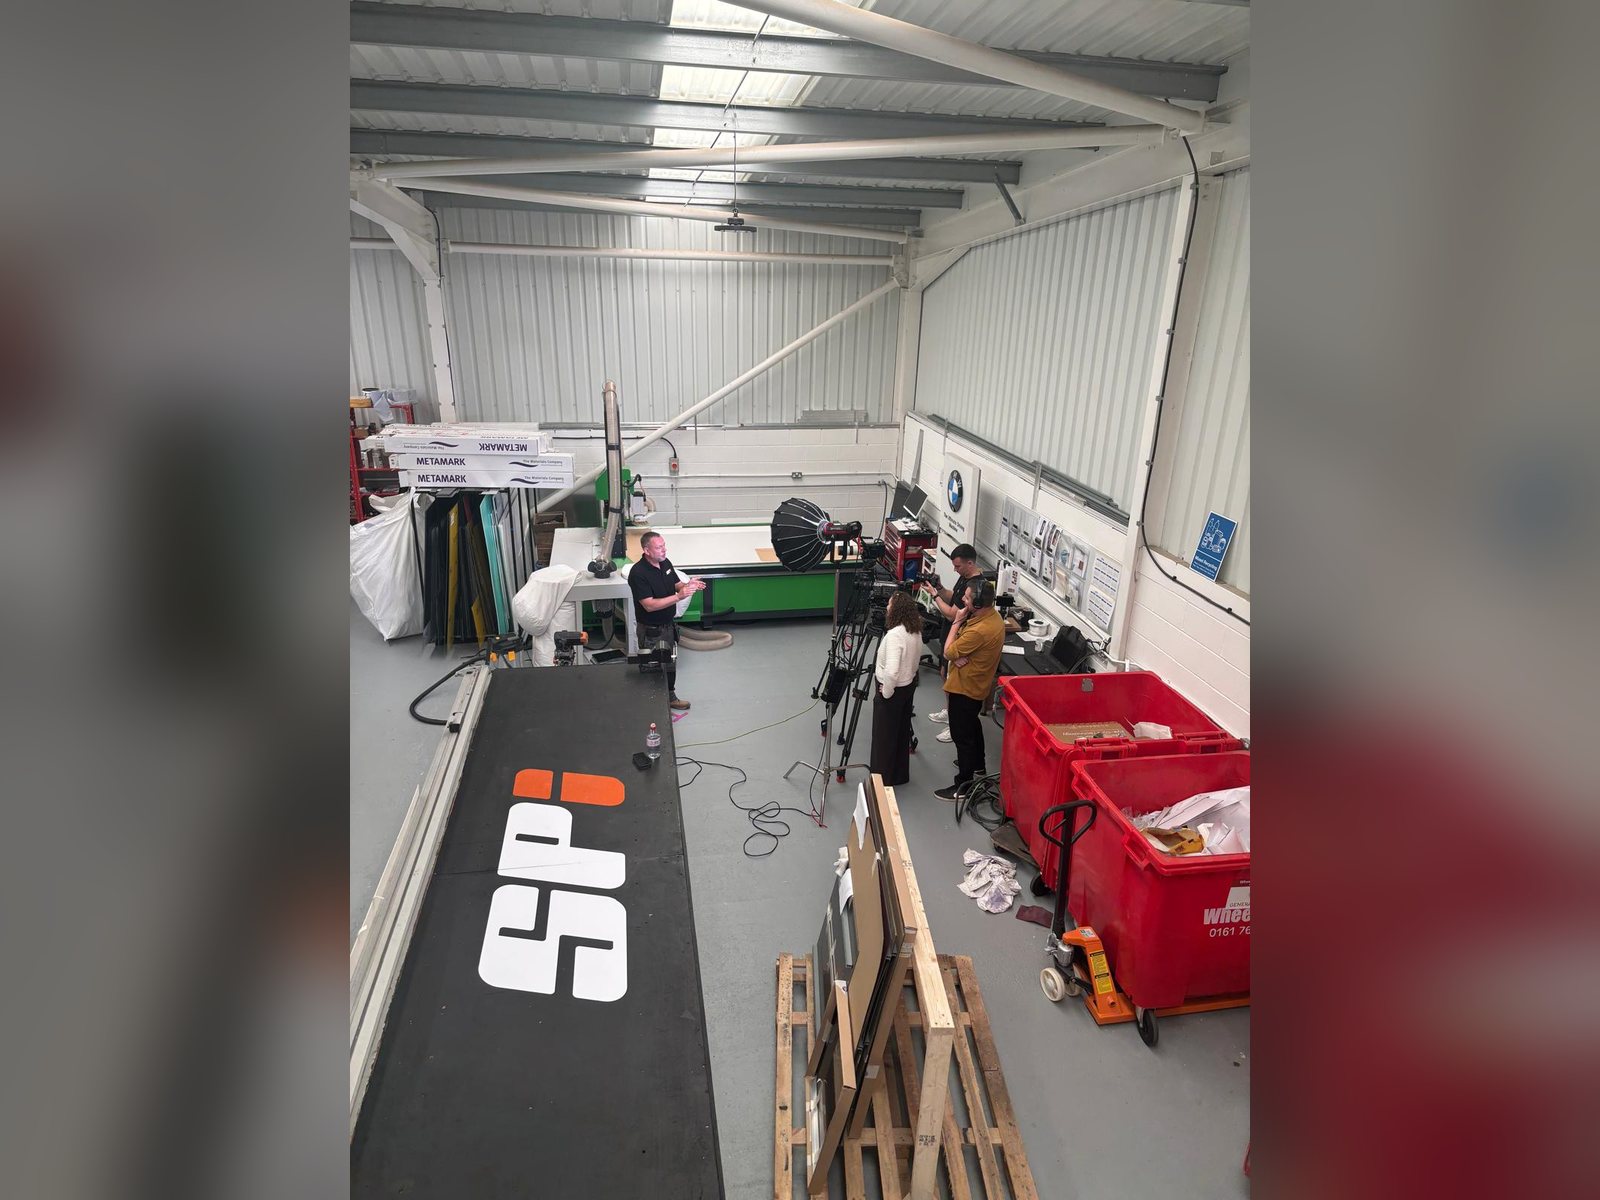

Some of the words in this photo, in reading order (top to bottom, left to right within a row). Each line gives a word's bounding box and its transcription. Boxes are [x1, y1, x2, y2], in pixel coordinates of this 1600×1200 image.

[479, 443, 528, 451] METAMARK
[416, 457, 466, 465] METAMARK
[418, 475, 467, 483] METAMARK
[1209, 927, 1234, 937] 0161
